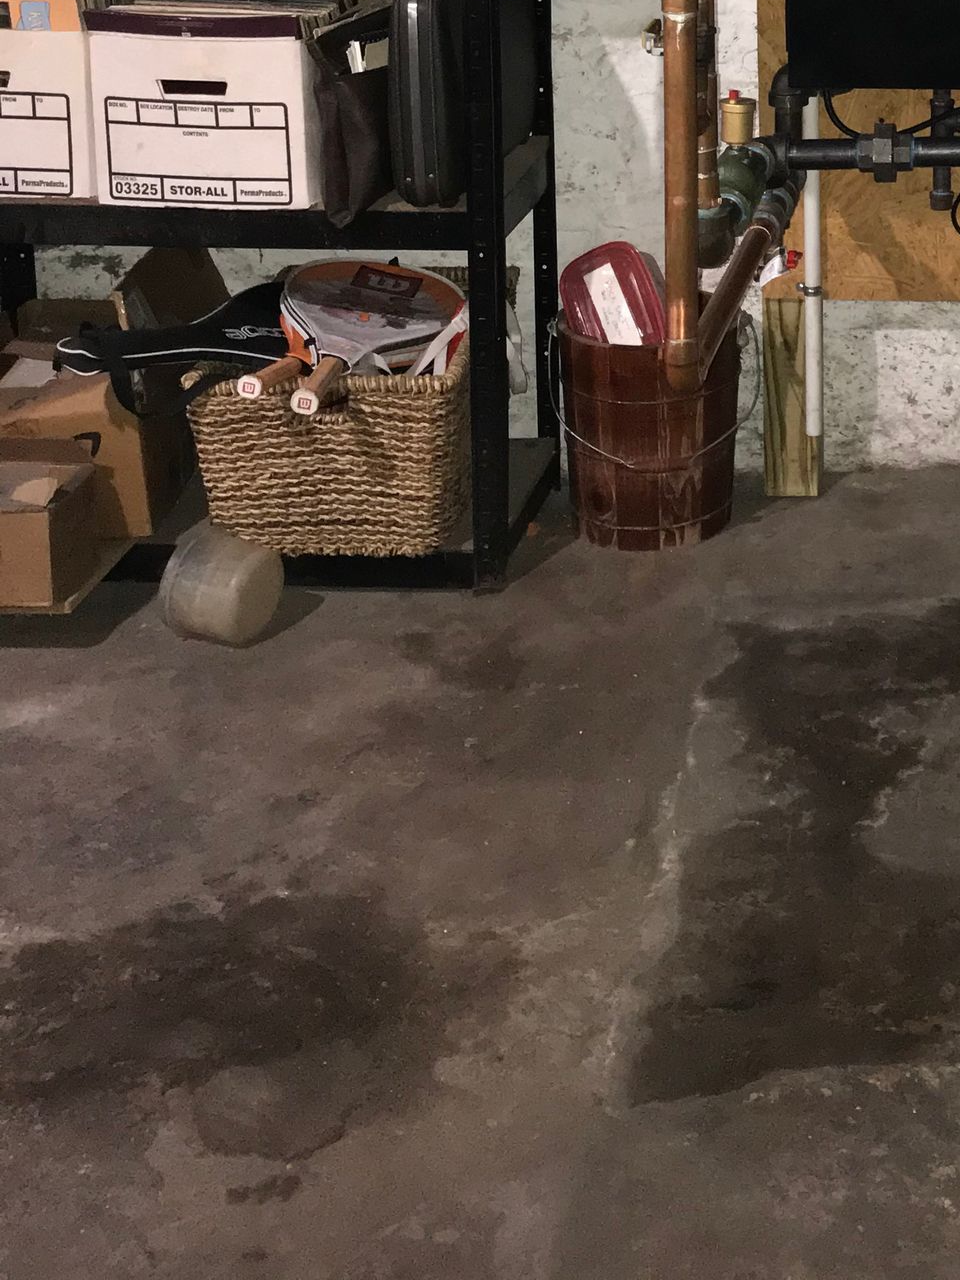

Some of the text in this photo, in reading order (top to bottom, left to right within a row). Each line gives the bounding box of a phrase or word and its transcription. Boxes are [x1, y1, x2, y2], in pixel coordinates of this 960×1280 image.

[21, 179, 65, 188] PermaProducts
[115, 181, 158, 196] 03325
[170, 185, 228, 197] STOR-ALL
[240, 189, 284, 197] PermaProducts
